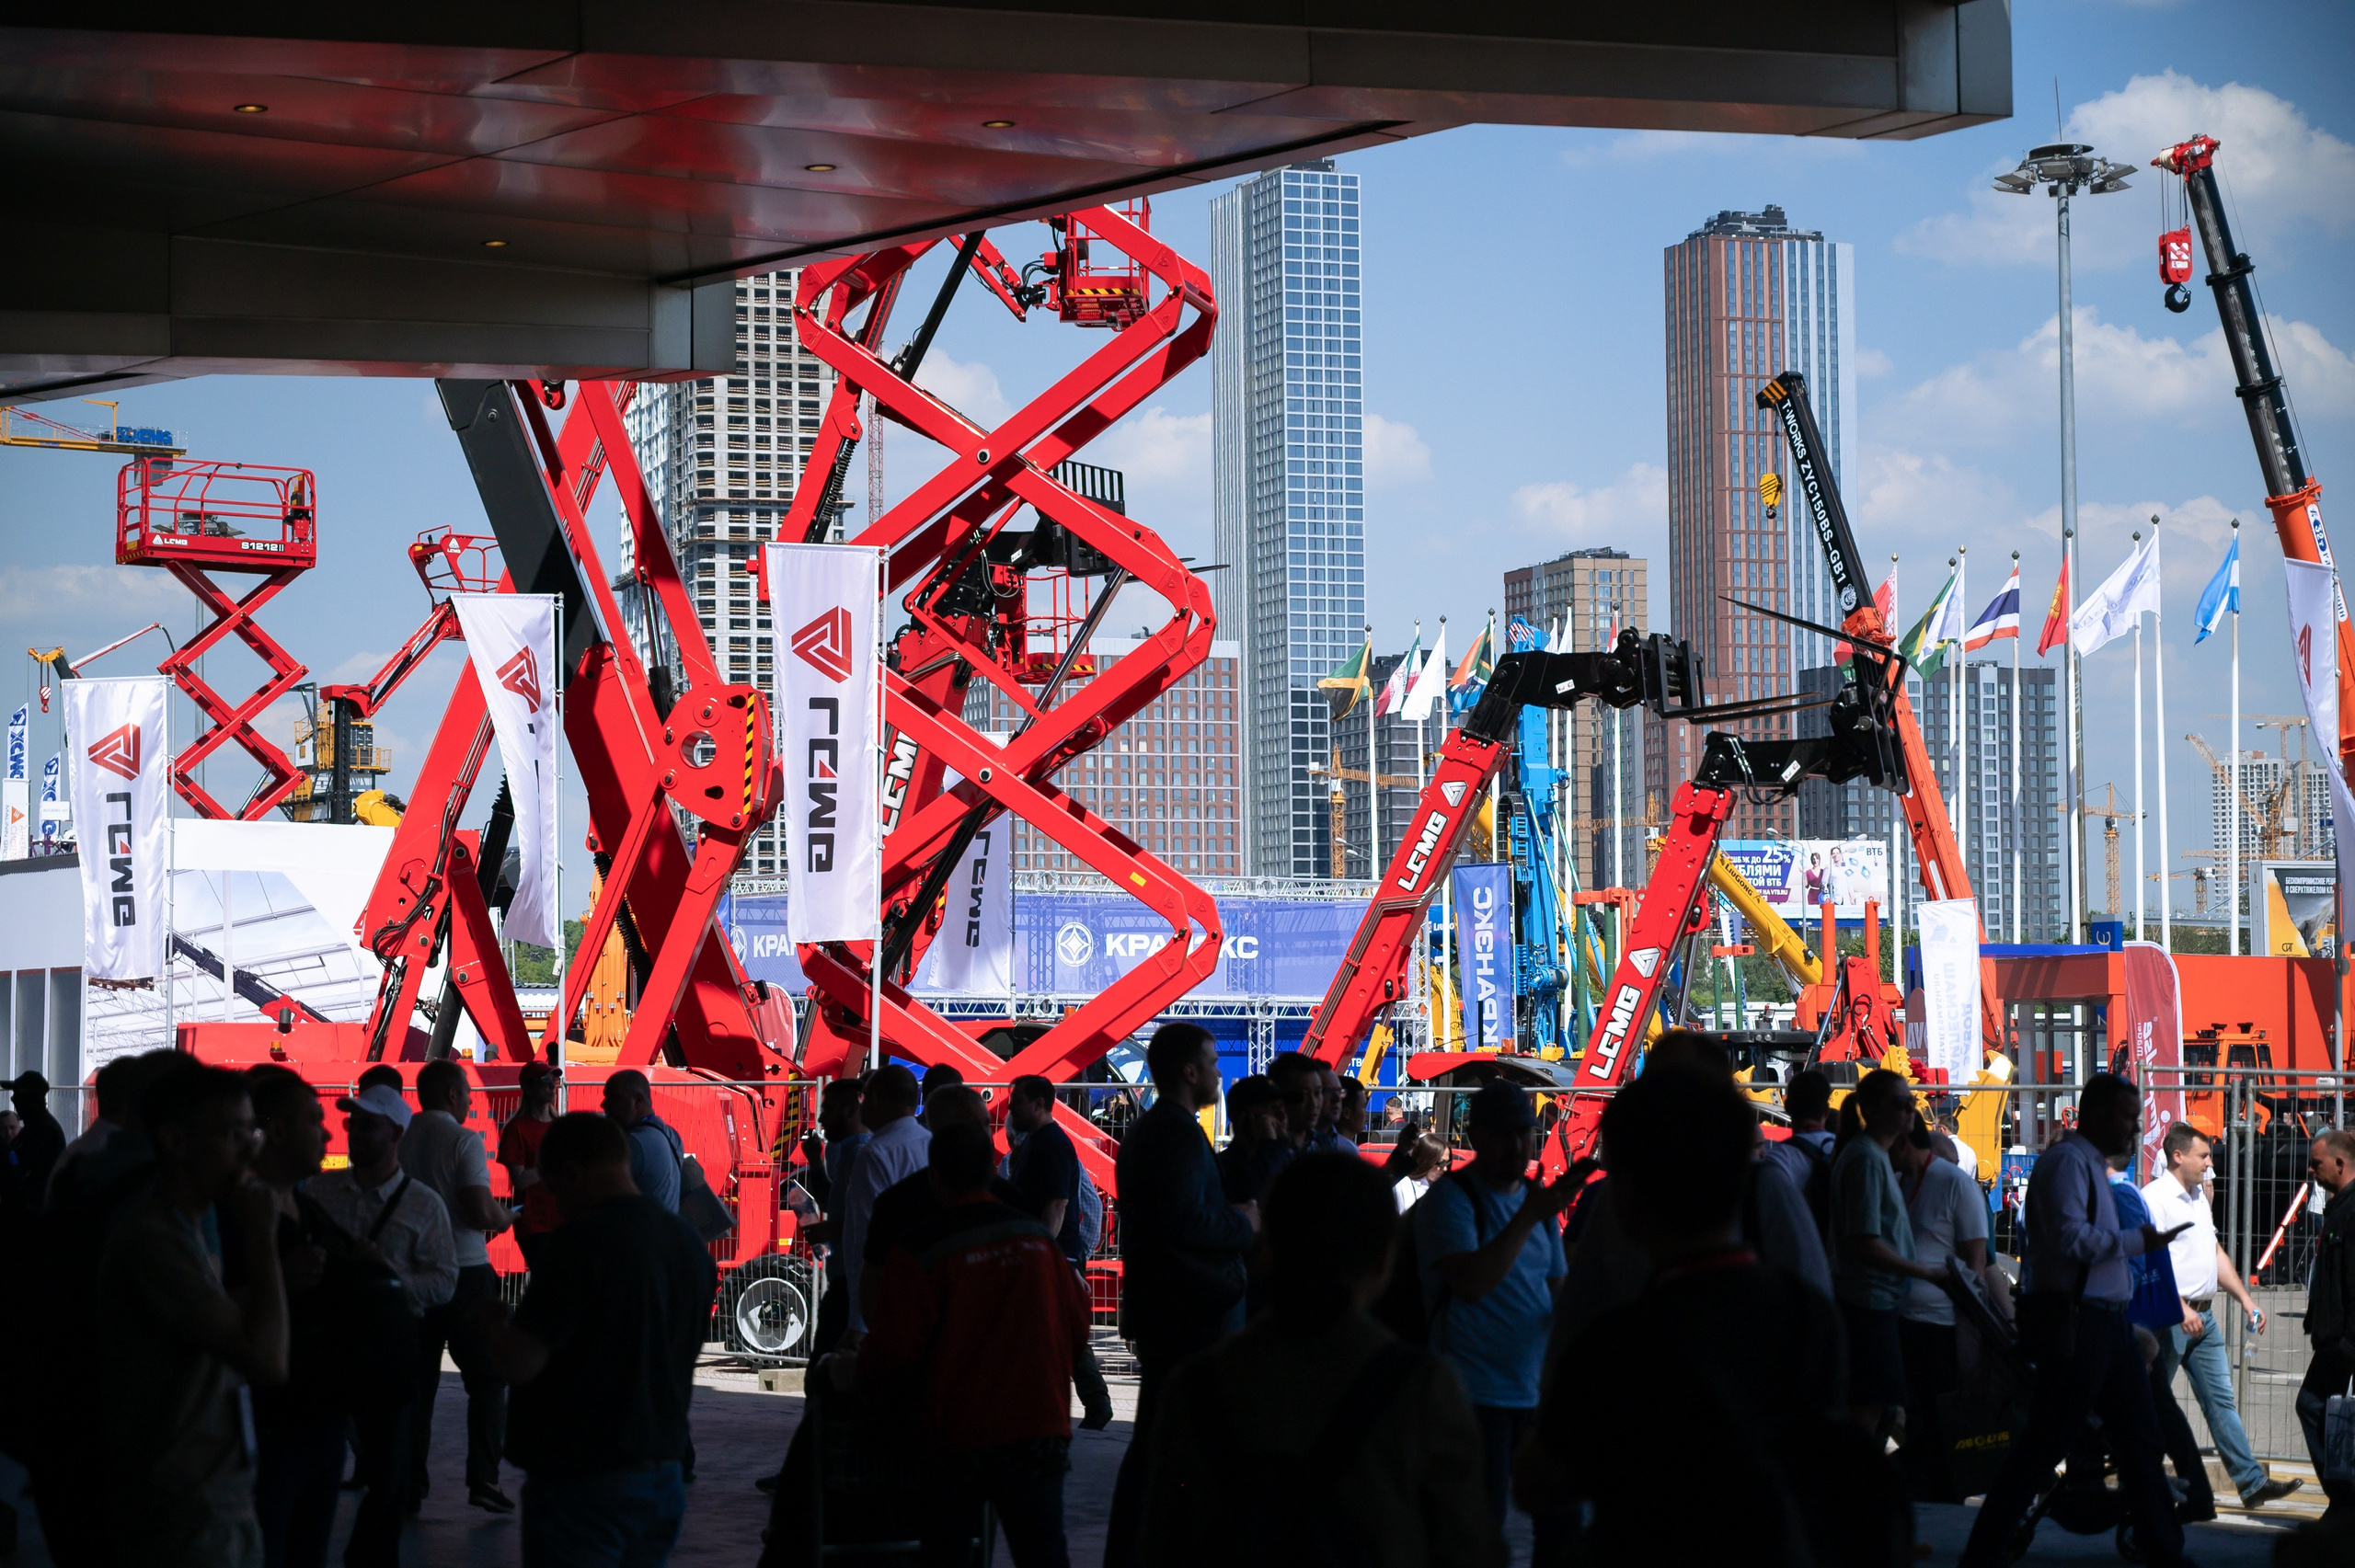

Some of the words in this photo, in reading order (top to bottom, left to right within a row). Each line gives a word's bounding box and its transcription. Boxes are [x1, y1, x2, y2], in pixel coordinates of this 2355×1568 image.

[1800, 459, 1846, 583] ZYC150BS-GB1
[883, 731, 918, 837] LCM
[1397, 809, 1449, 892] LCMG
[1735, 864, 1782, 876] БЛЯМИ
[1867, 848, 1883, 856] ВТБ
[1749, 876, 1765, 887] ТОЙ
[1766, 877, 1782, 887] ВТБ
[1106, 933, 1258, 959] КРАКС
[1589, 983, 1642, 1080] LCMG
